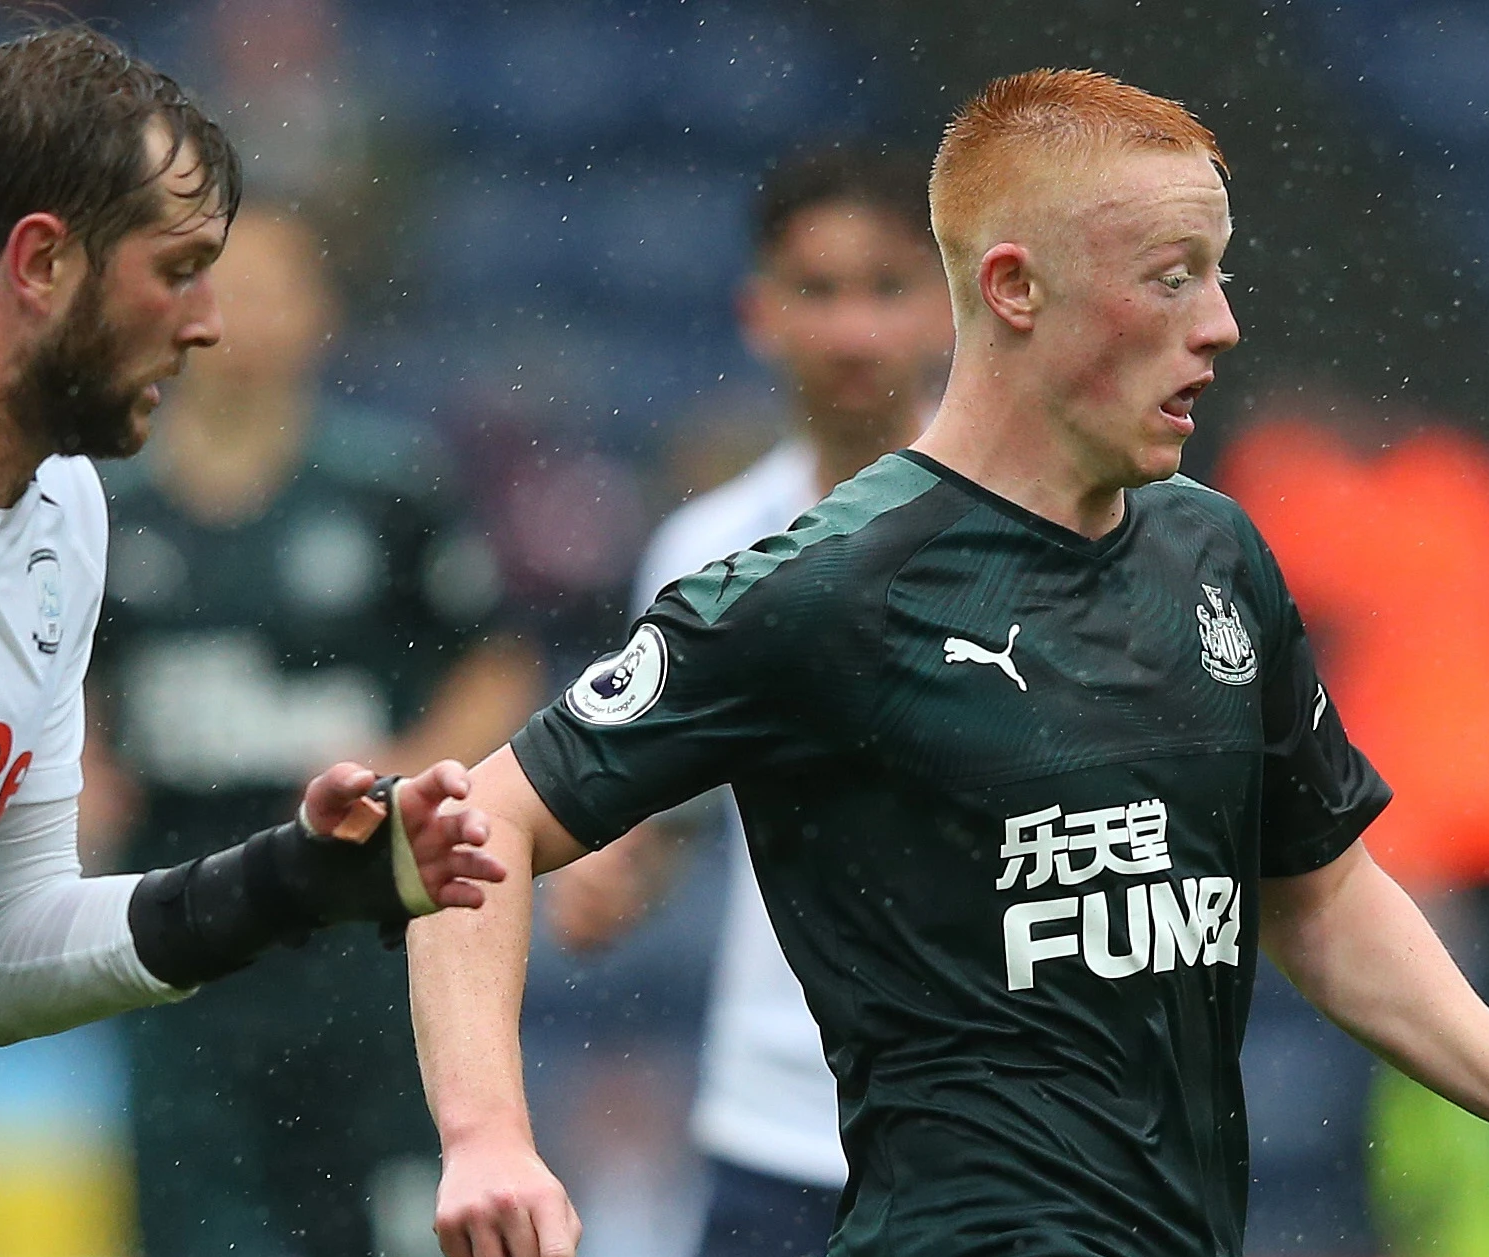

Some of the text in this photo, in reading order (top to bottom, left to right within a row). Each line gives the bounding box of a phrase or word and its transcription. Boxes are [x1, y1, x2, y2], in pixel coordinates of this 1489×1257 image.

[582, 694, 636, 714] Premier League
[995, 798, 1174, 890] 乐天堂
